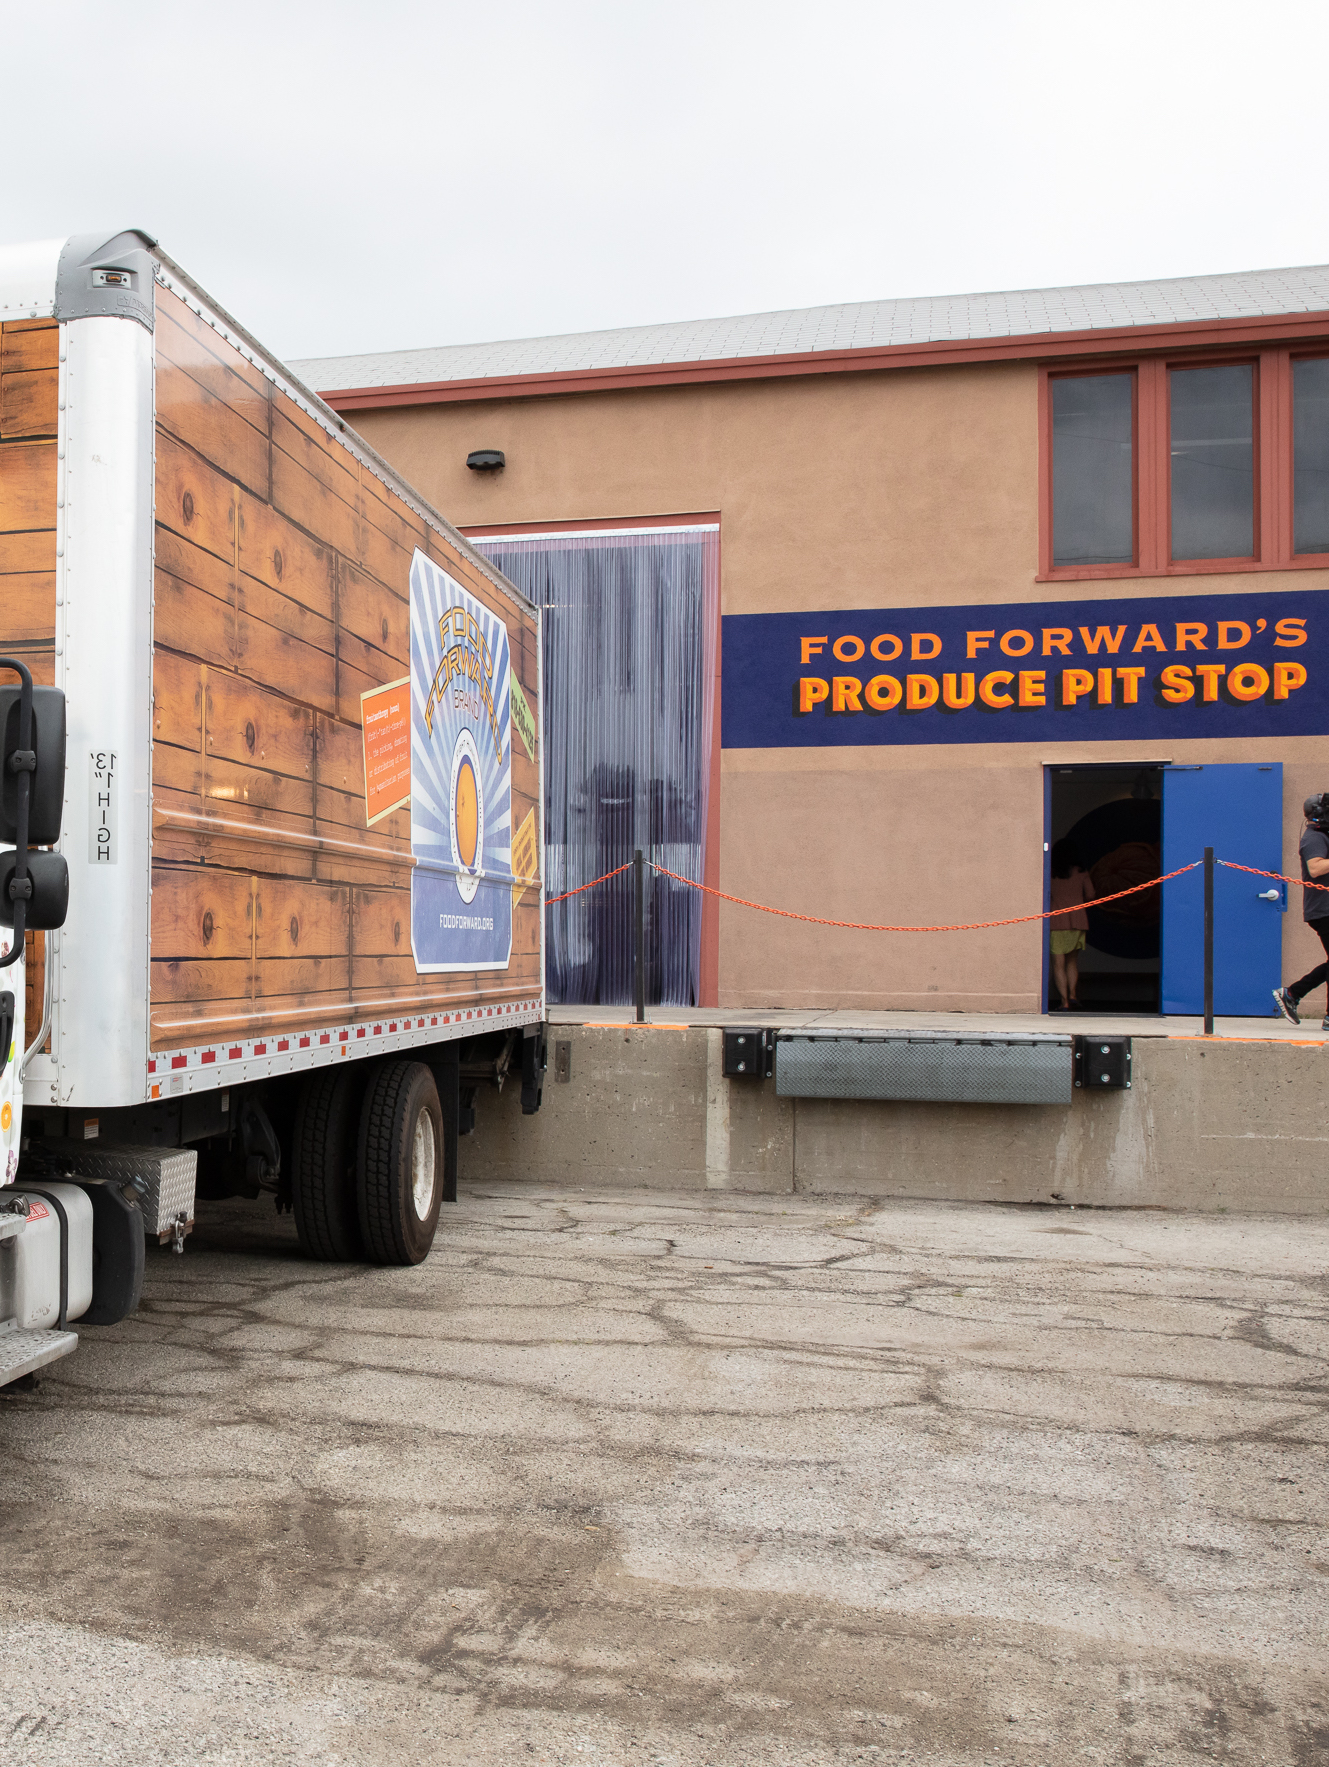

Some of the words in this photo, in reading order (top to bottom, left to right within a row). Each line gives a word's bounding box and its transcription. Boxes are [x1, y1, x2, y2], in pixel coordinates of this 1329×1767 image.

[438, 605, 493, 679] FOOD
[799, 633, 942, 664] FOOD
[965, 618, 1308, 659] FORWARD'S
[425, 643, 502, 766] FORWARD
[454, 688, 479, 721] BRAND
[797, 670, 1046, 715] PRODUCE
[1061, 667, 1146, 706] PIT
[1160, 662, 1307, 704] STOP
[439, 914, 494, 931] FOODFORWARD.ORG
